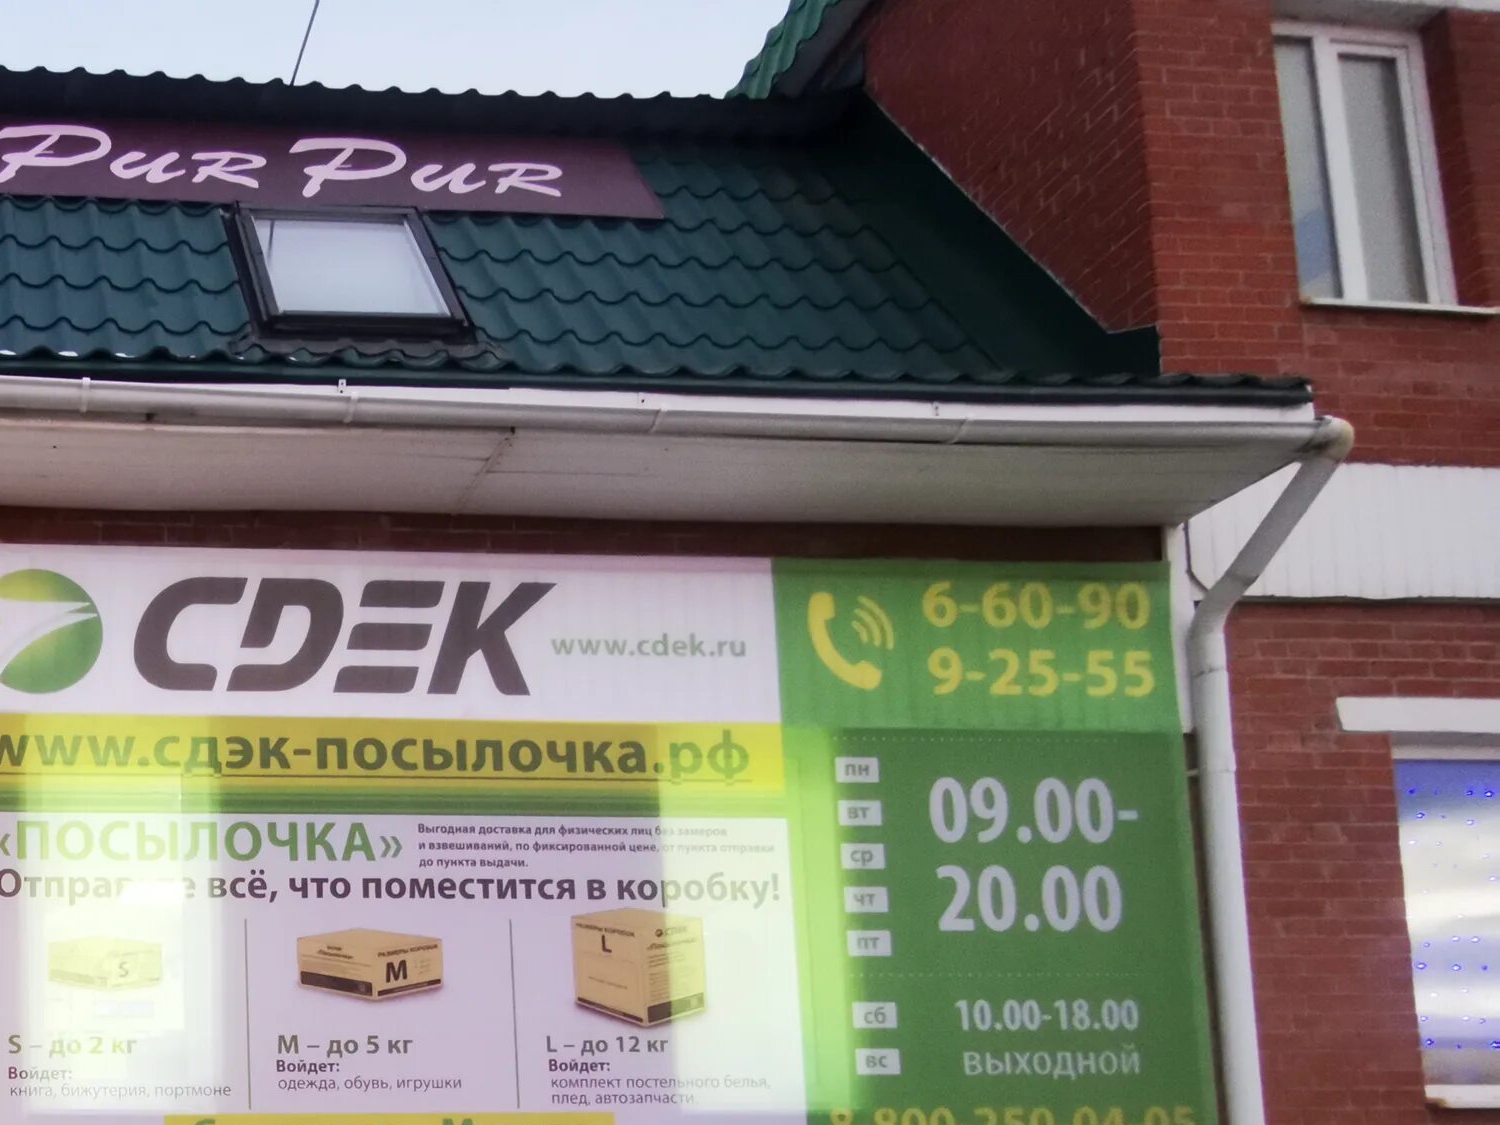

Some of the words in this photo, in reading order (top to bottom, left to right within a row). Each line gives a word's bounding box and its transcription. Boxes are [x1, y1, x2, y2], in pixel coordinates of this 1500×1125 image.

[921, 580, 1151, 630] 6-60-90
[133, 576, 558, 697] CDEK
[551, 633, 747, 659] www.cdek.ru
[927, 647, 1155, 697] 9-25-55
[928, 776, 1139, 843] 09.00-
[418, 823, 475, 835] Выгодная
[478, 825, 531, 835] доставка
[534, 826, 555, 836] для
[558, 825, 628, 836] физических
[631, 827, 652, 837] лиц
[418, 842, 426, 850] и
[429, 841, 512, 852] взвешиваний,
[532, 841, 626, 853] фиксированной
[629, 844, 660, 853] цене,
[419, 858, 433, 868] до
[436, 858, 476, 869] пункта
[480, 859, 528, 869] выдачи.
[207, 869, 279, 903] всё,
[289, 877, 350, 899] что
[362, 877, 576, 901] поместится
[587, 878, 606, 900] в
[617, 872, 781, 909] коробку!
[936, 864, 1123, 932] 20.00
[601, 934, 612, 953] L
[118, 961, 129, 977] S
[385, 959, 407, 983] M
[864, 1006, 886, 1025] сб
[955, 998, 1139, 1031] 10.00-18.00
[8, 1034, 22, 1054] S
[49, 1038, 82, 1058] до
[89, 1036, 103, 1054] 2
[112, 1039, 137, 1054] кг
[277, 1036, 299, 1054] M
[326, 1039, 359, 1058] до
[366, 1035, 380, 1054] 5
[387, 1039, 413, 1054] кг
[546, 1035, 558, 1053] L
[580, 1039, 608, 1057] до
[615, 1035, 641, 1053] 12
[647, 1038, 669, 1053] кг
[276, 1059, 340, 1077] Войдет:
[548, 1058, 611, 1076] Войдет:
[865, 1055, 888, 1069] вс
[8, 1065, 72, 1083] Войдет:
[278, 1077, 340, 1092] одежда,
[344, 1075, 393, 1092] обувь,
[396, 1076, 462, 1091] игрушки
[551, 1076, 621, 1091] комплект
[626, 1076, 719, 1090] постельного
[723, 1074, 771, 1091] белья,
[10, 1084, 57, 1099] книга,
[60, 1082, 150, 1100] бижутерия,
[154, 1085, 231, 1100] портмоне
[551, 1092, 590, 1107] плед,
